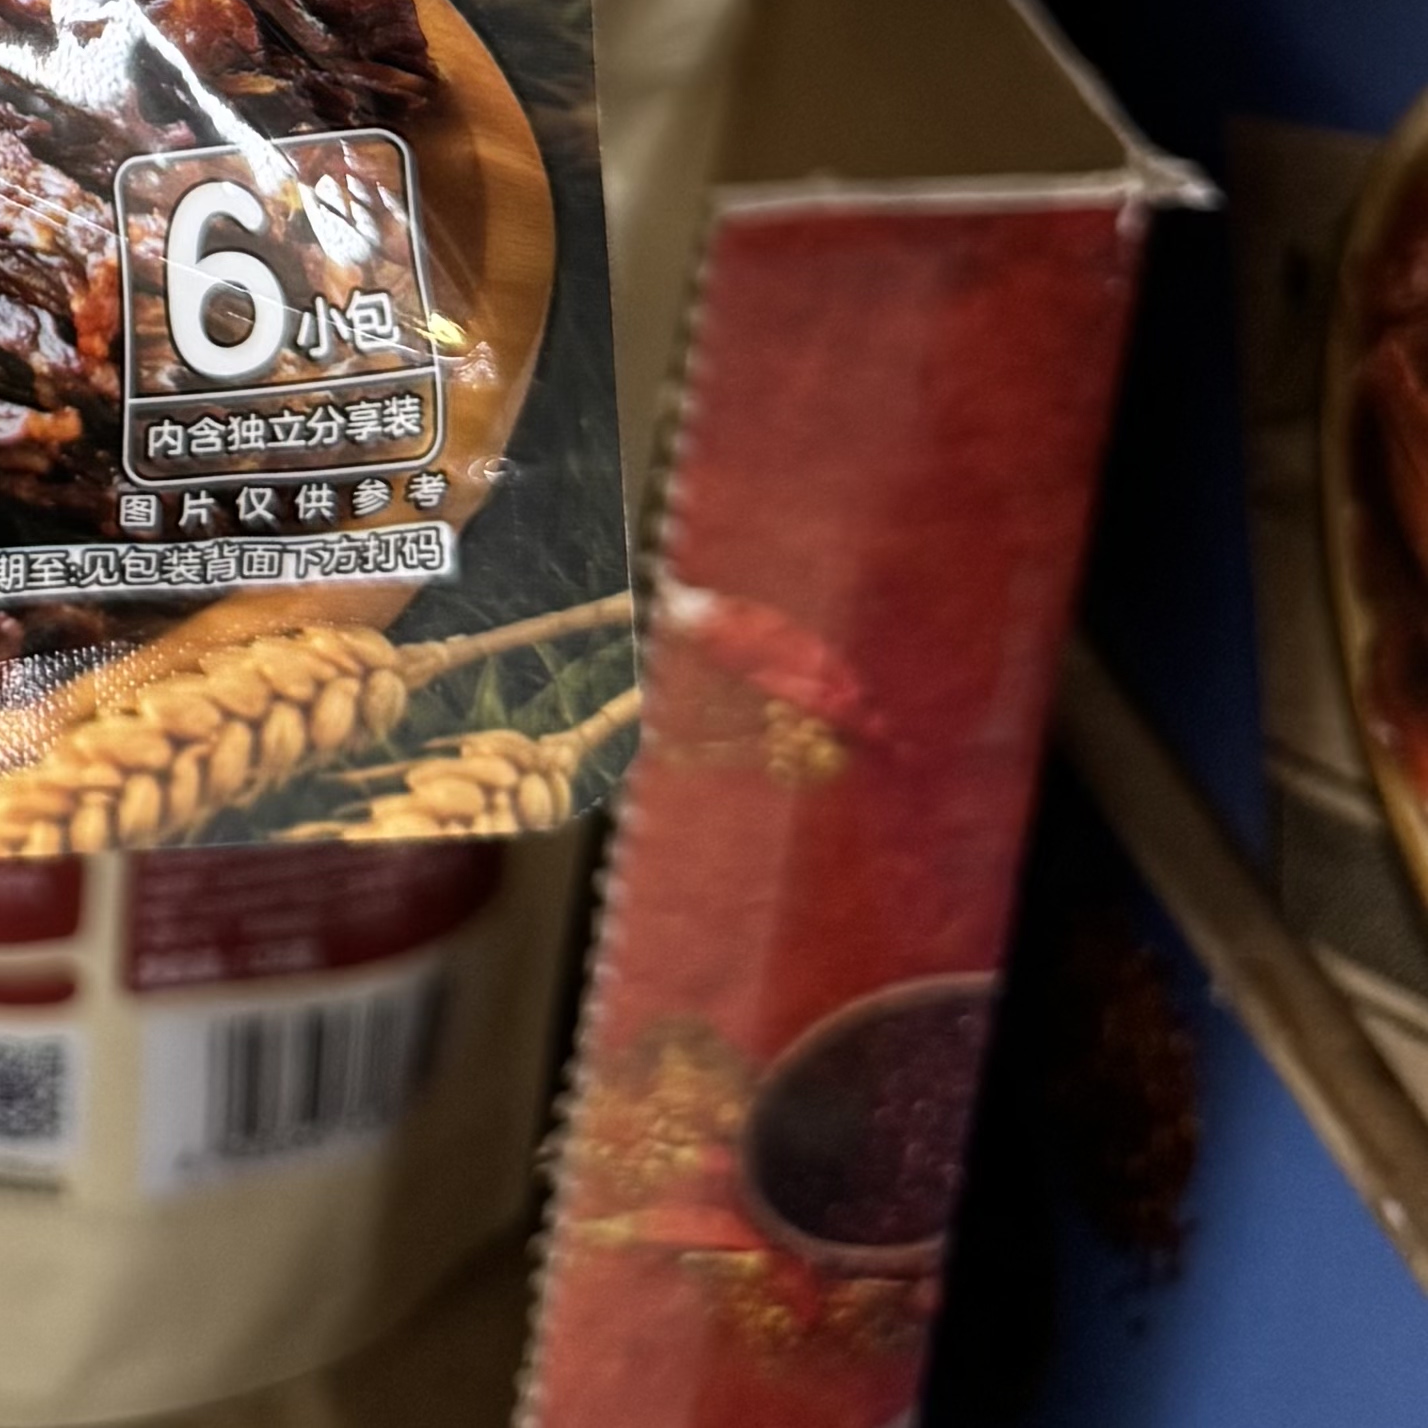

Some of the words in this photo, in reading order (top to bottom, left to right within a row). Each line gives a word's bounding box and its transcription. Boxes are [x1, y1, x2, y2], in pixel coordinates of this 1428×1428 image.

[146, 394, 423, 459] 内含独立分享装
[119, 472, 447, 528] 图片仅供参考
